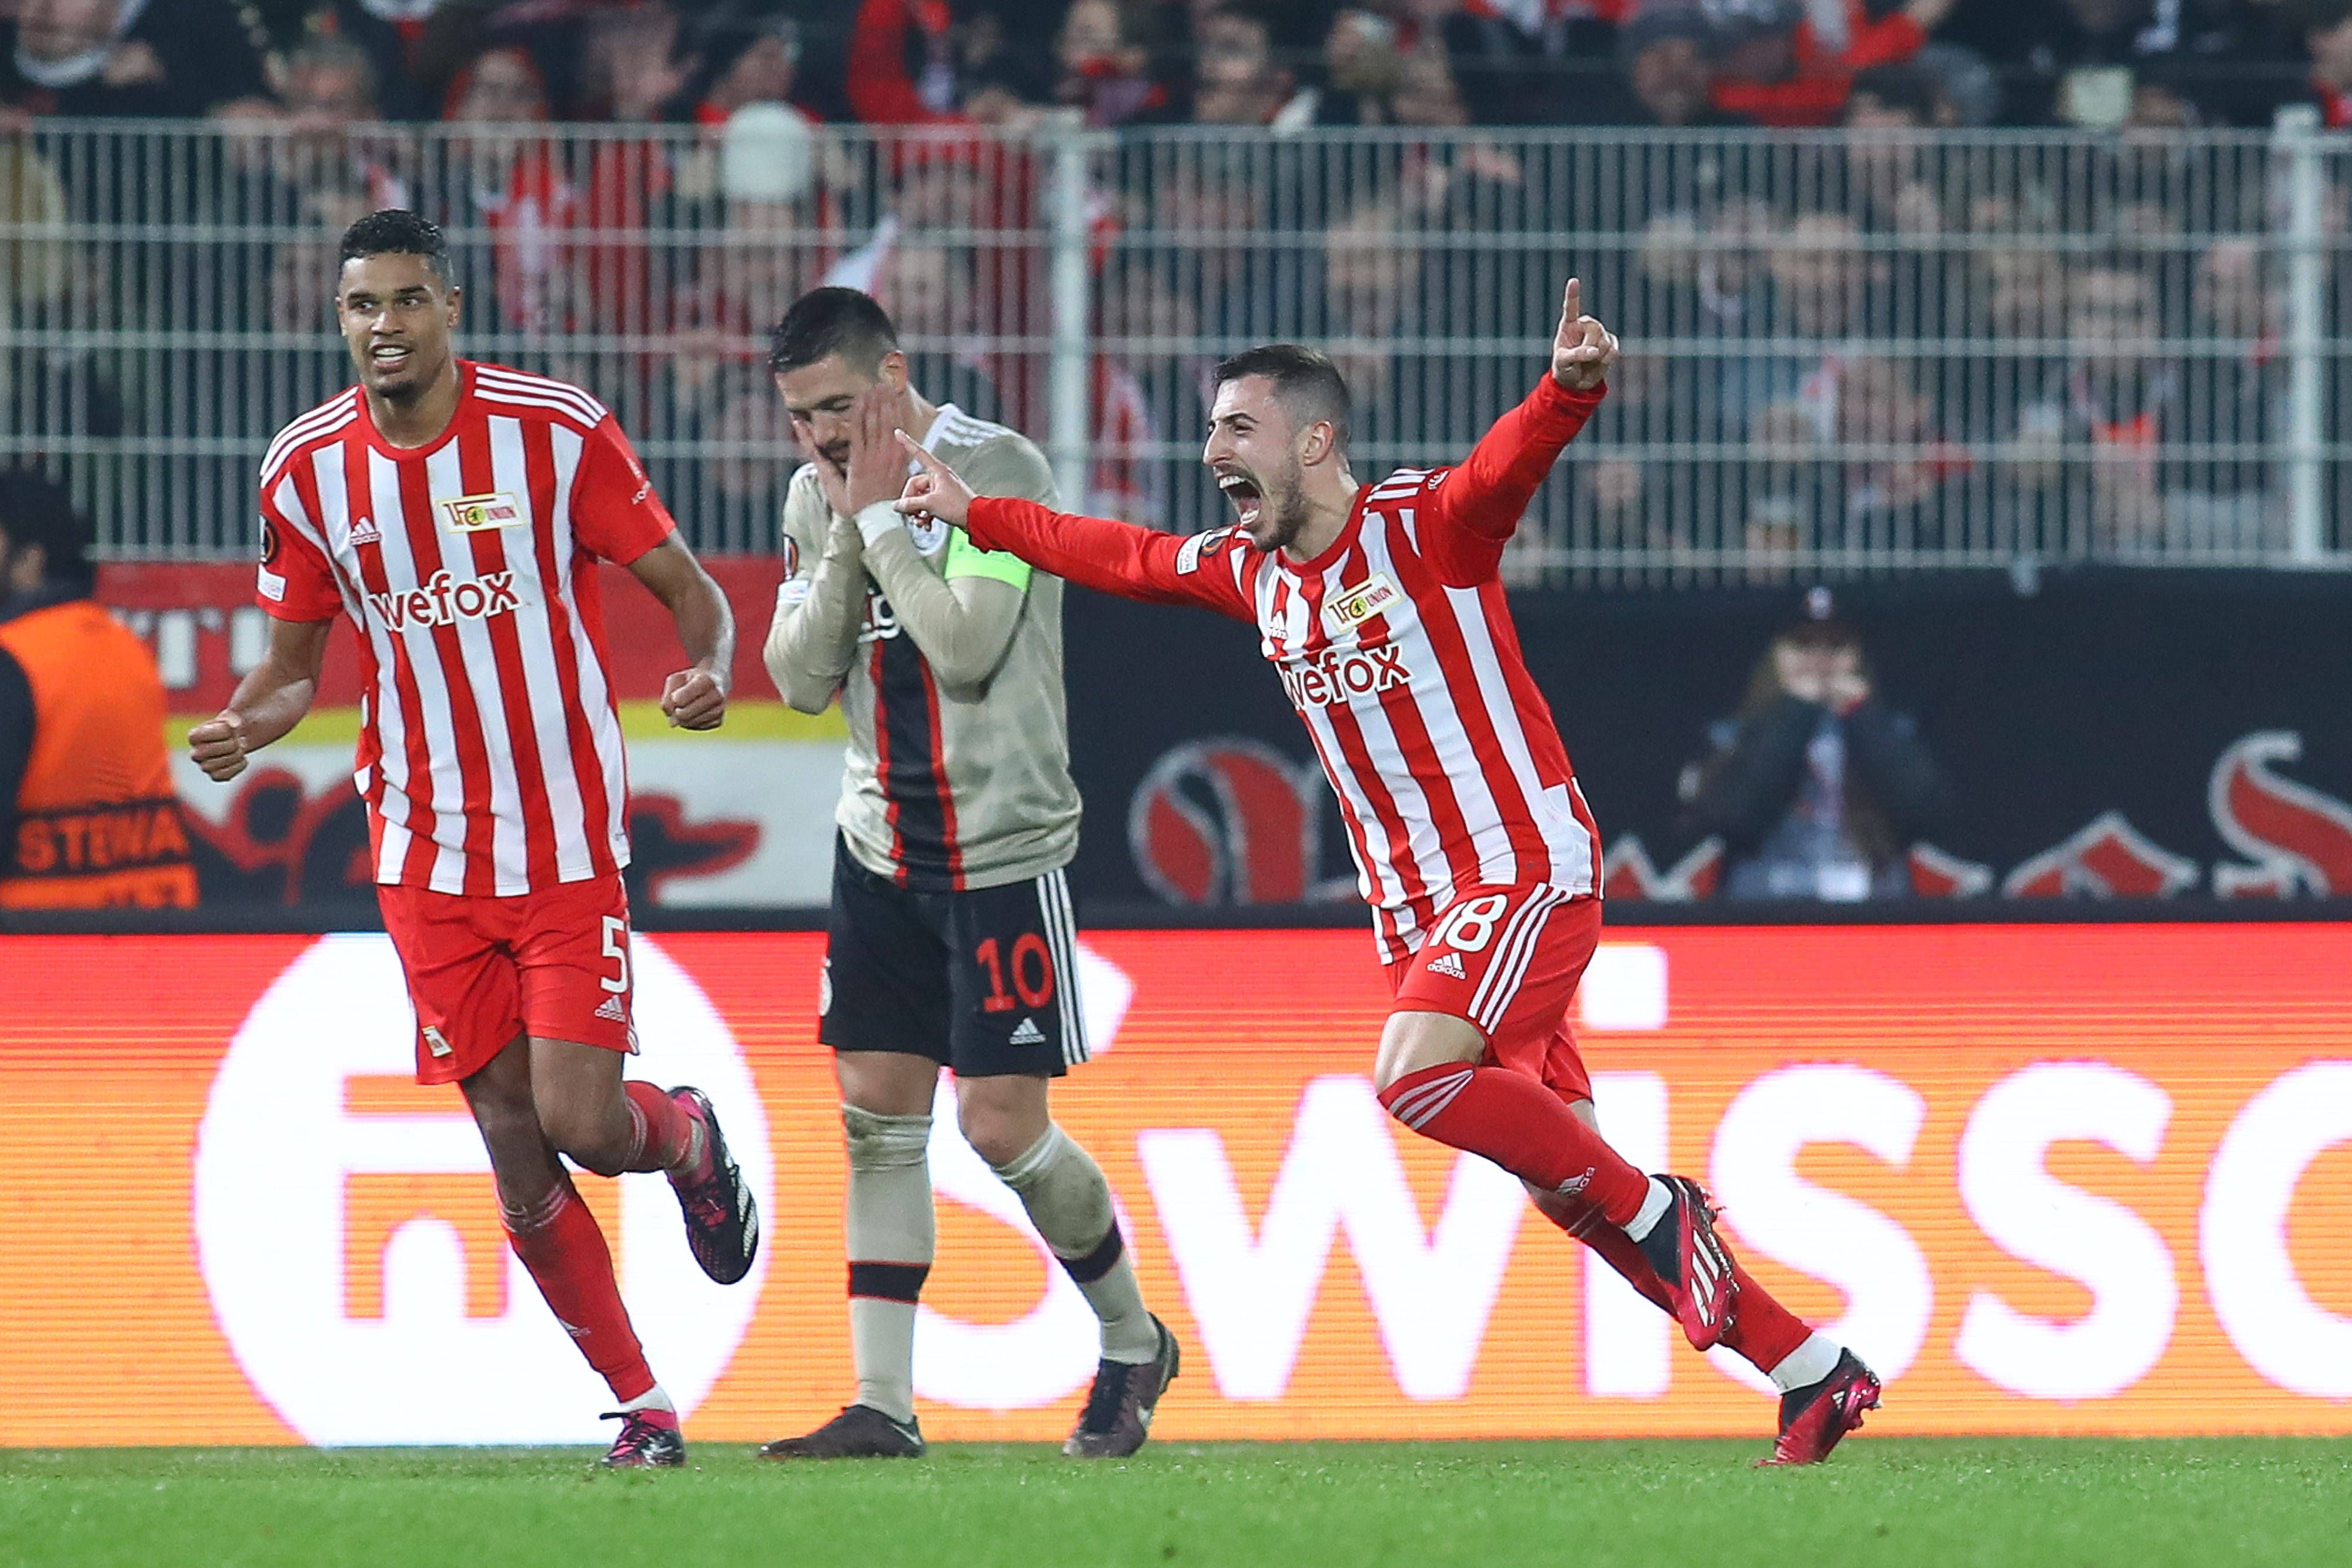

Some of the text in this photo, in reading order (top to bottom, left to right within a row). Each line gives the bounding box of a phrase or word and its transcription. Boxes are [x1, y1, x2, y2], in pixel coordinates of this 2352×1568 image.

[368, 569, 522, 632] wefox
[1280, 643, 1414, 709] wefox
[600, 915, 628, 994] 5
[1428, 894, 1508, 952] 18
[976, 932, 1055, 1012] 10
[1426, 963, 1466, 979] adidas
